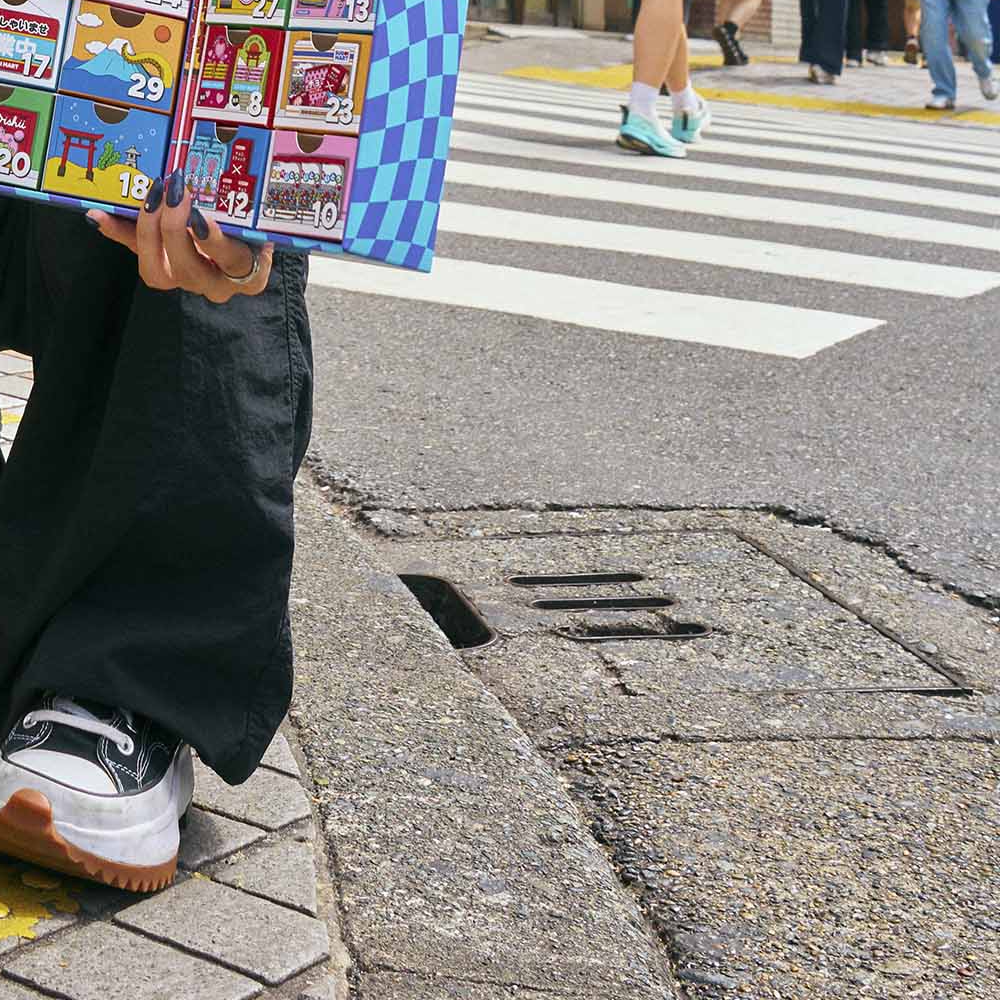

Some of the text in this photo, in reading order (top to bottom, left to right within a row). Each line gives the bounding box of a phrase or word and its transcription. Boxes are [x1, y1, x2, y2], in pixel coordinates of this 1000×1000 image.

[22, 52, 51, 80] 17
[127, 73, 165, 102] 29
[248, 91, 263, 117] 8
[325, 97, 354, 125] 23
[119, 170, 151, 200] 18
[226, 190, 250, 219] 12
[312, 201, 339, 230] 10
